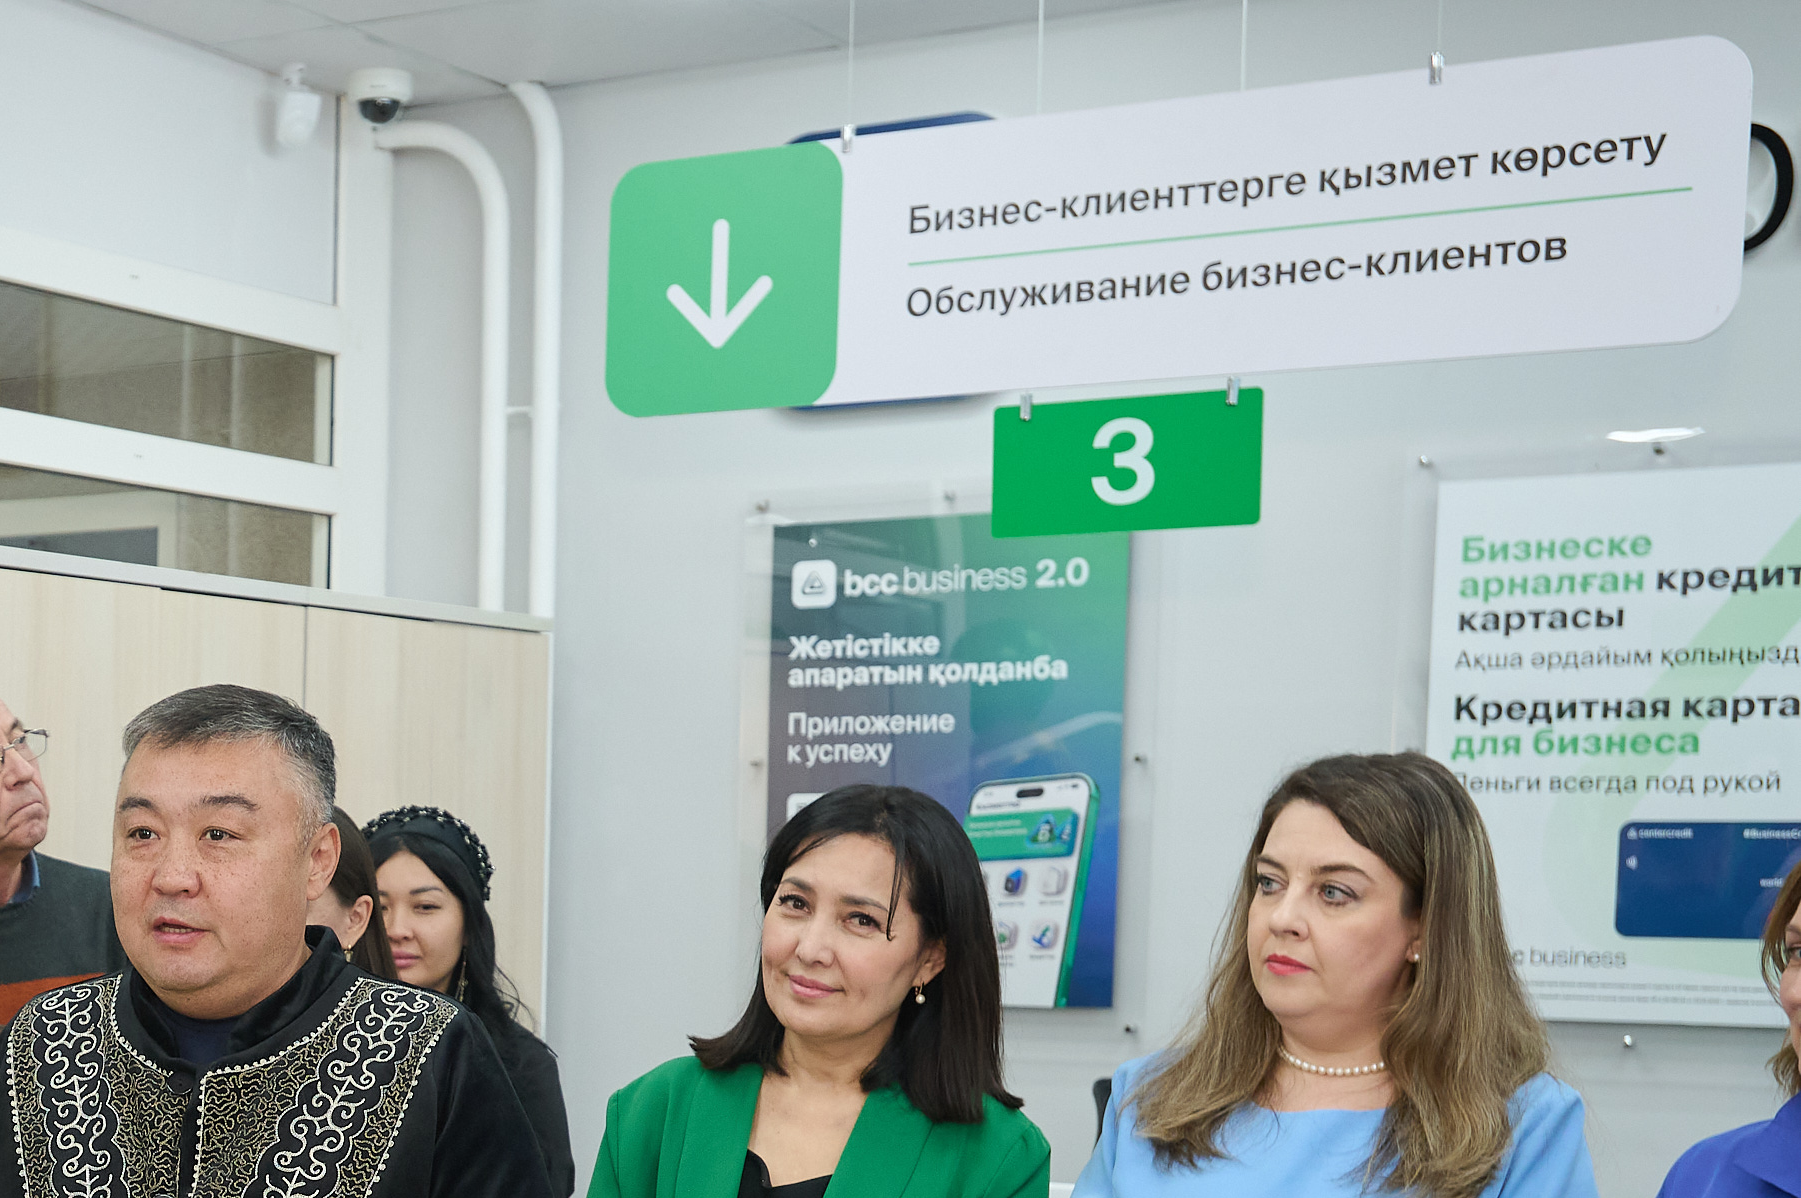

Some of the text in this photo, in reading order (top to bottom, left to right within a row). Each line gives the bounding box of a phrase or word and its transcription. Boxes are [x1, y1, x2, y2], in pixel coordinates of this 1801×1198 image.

[907, 130, 1668, 236] Бизнес-клиенттерге қызмет көрсету
[905, 234, 1568, 319] Обслуживание бизнес-клиентов
[1090, 416, 1156, 506] 3
[1460, 534, 1653, 564] Бизнеске
[1034, 555, 1090, 588] 2.0
[1458, 565, 1801, 603] арналған кредит
[1458, 607, 1625, 637] картасы
[788, 632, 941, 662] Жетістікке
[1454, 650, 1524, 673] Ақша
[1530, 647, 1653, 671] әрдайым
[787, 654, 1069, 690] апаратын қолданба
[787, 710, 956, 738] Приложение
[1454, 694, 1801, 727] Кредитная карта
[787, 740, 893, 768] к успеху
[1450, 729, 1700, 762] для бизнеса
[1548, 774, 1638, 795] всегда
[1644, 774, 1696, 795] под
[1702, 769, 1782, 795] рукой
[1529, 945, 1628, 969] business
